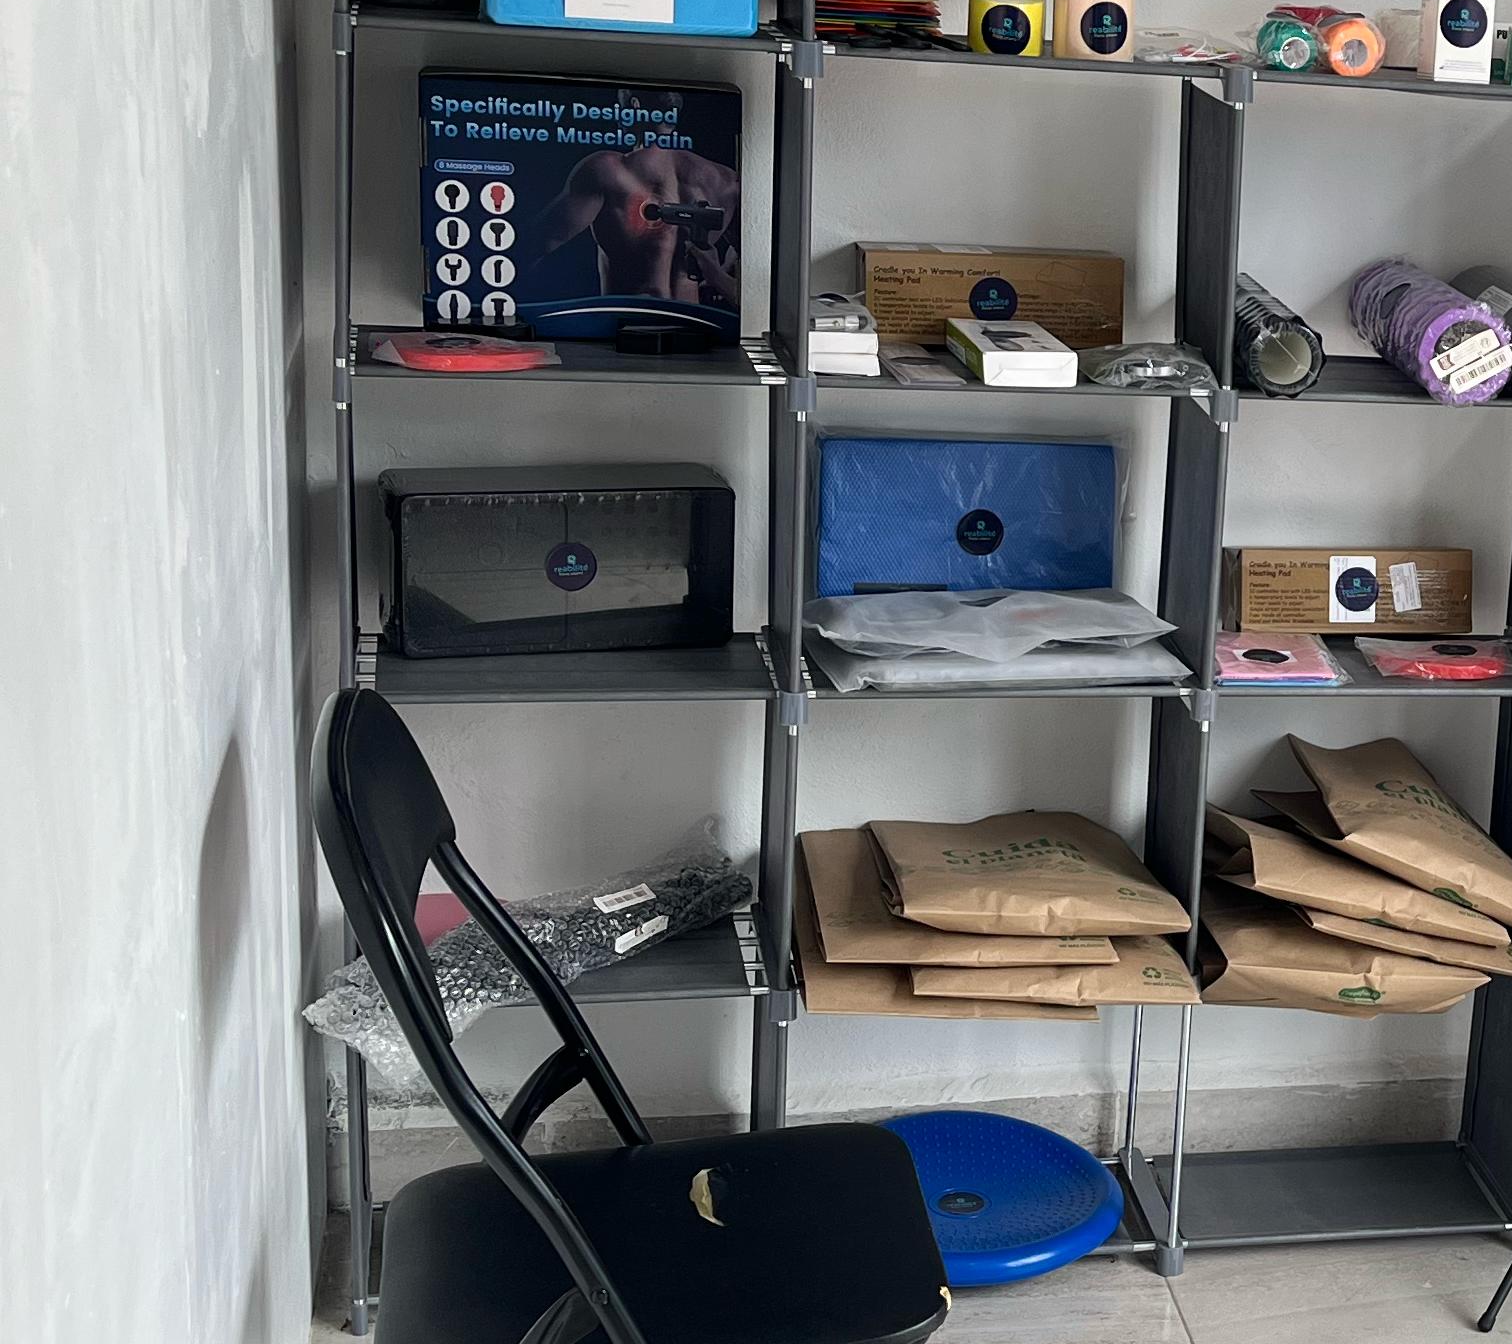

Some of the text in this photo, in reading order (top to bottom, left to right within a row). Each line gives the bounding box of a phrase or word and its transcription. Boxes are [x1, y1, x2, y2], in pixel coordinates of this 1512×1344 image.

[430, 95, 678, 127] Specifically Designed
[430, 120, 693, 149] To Relieve Muscle Pain
[446, 162, 483, 172] Massage
[484, 164, 510, 172] Heads
[906, 276, 921, 284] Pad
